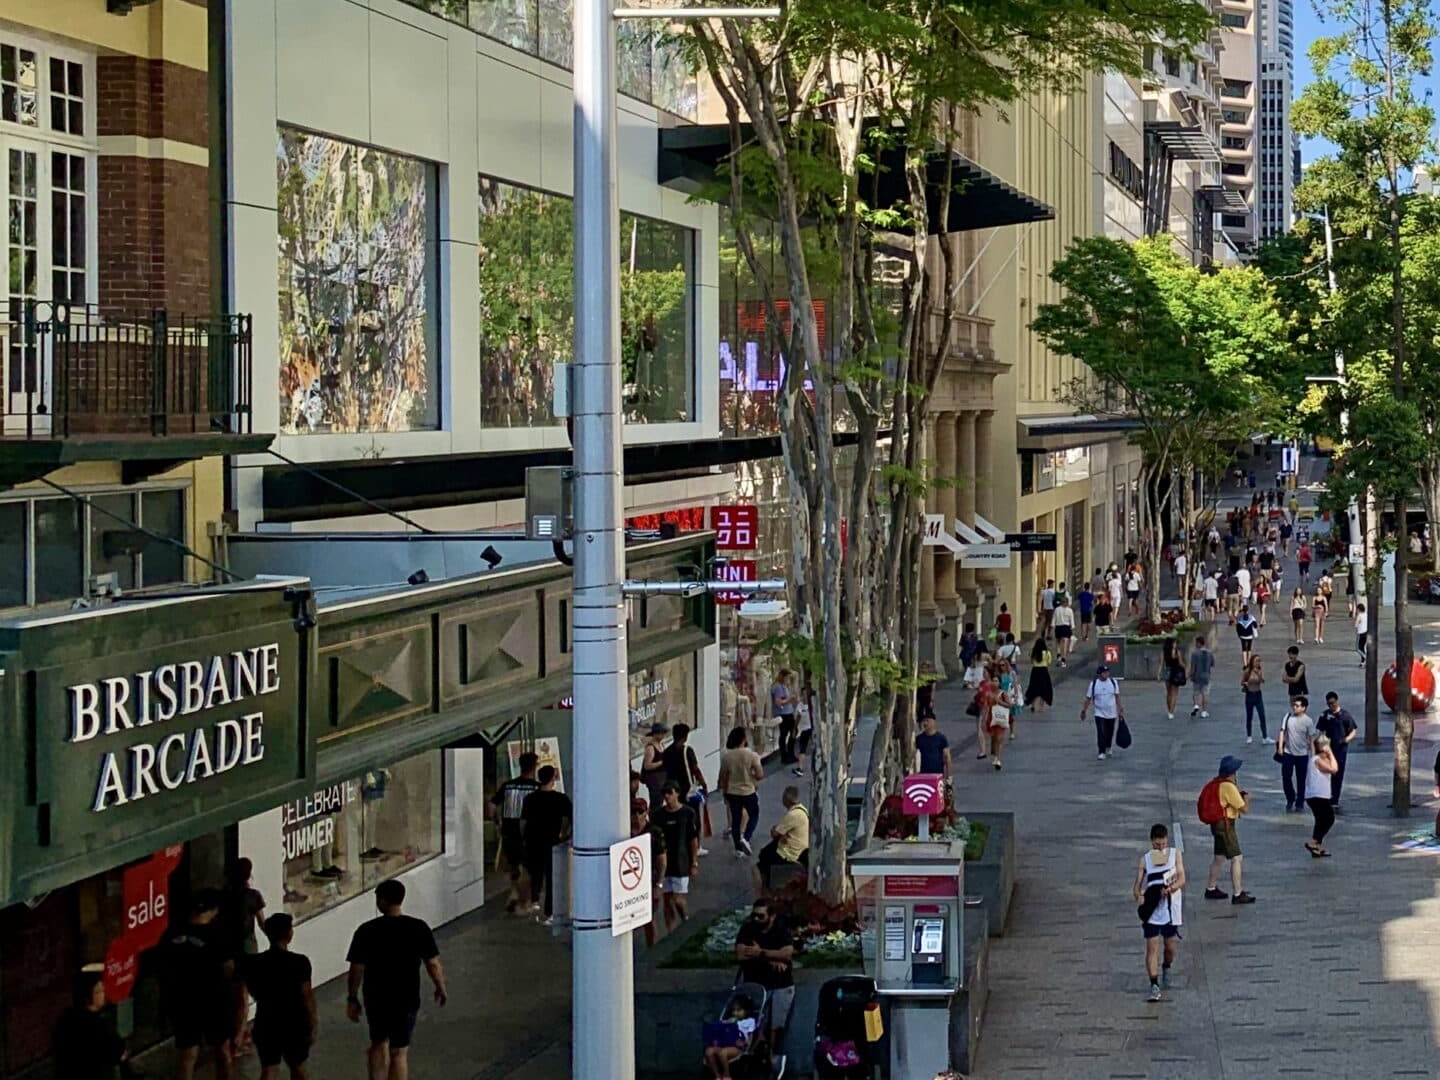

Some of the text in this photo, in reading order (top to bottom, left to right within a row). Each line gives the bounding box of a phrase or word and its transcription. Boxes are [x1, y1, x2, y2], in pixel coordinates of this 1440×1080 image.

[717, 529, 750, 544] クロ
[718, 511, 750, 526] ユニ
[68, 643, 281, 743] BRISBANE
[92, 711, 265, 813] ARCADE
[281, 817, 334, 863] SUMMER
[128, 880, 166, 929] sale
[614, 892, 649, 911] NO SMOKING
